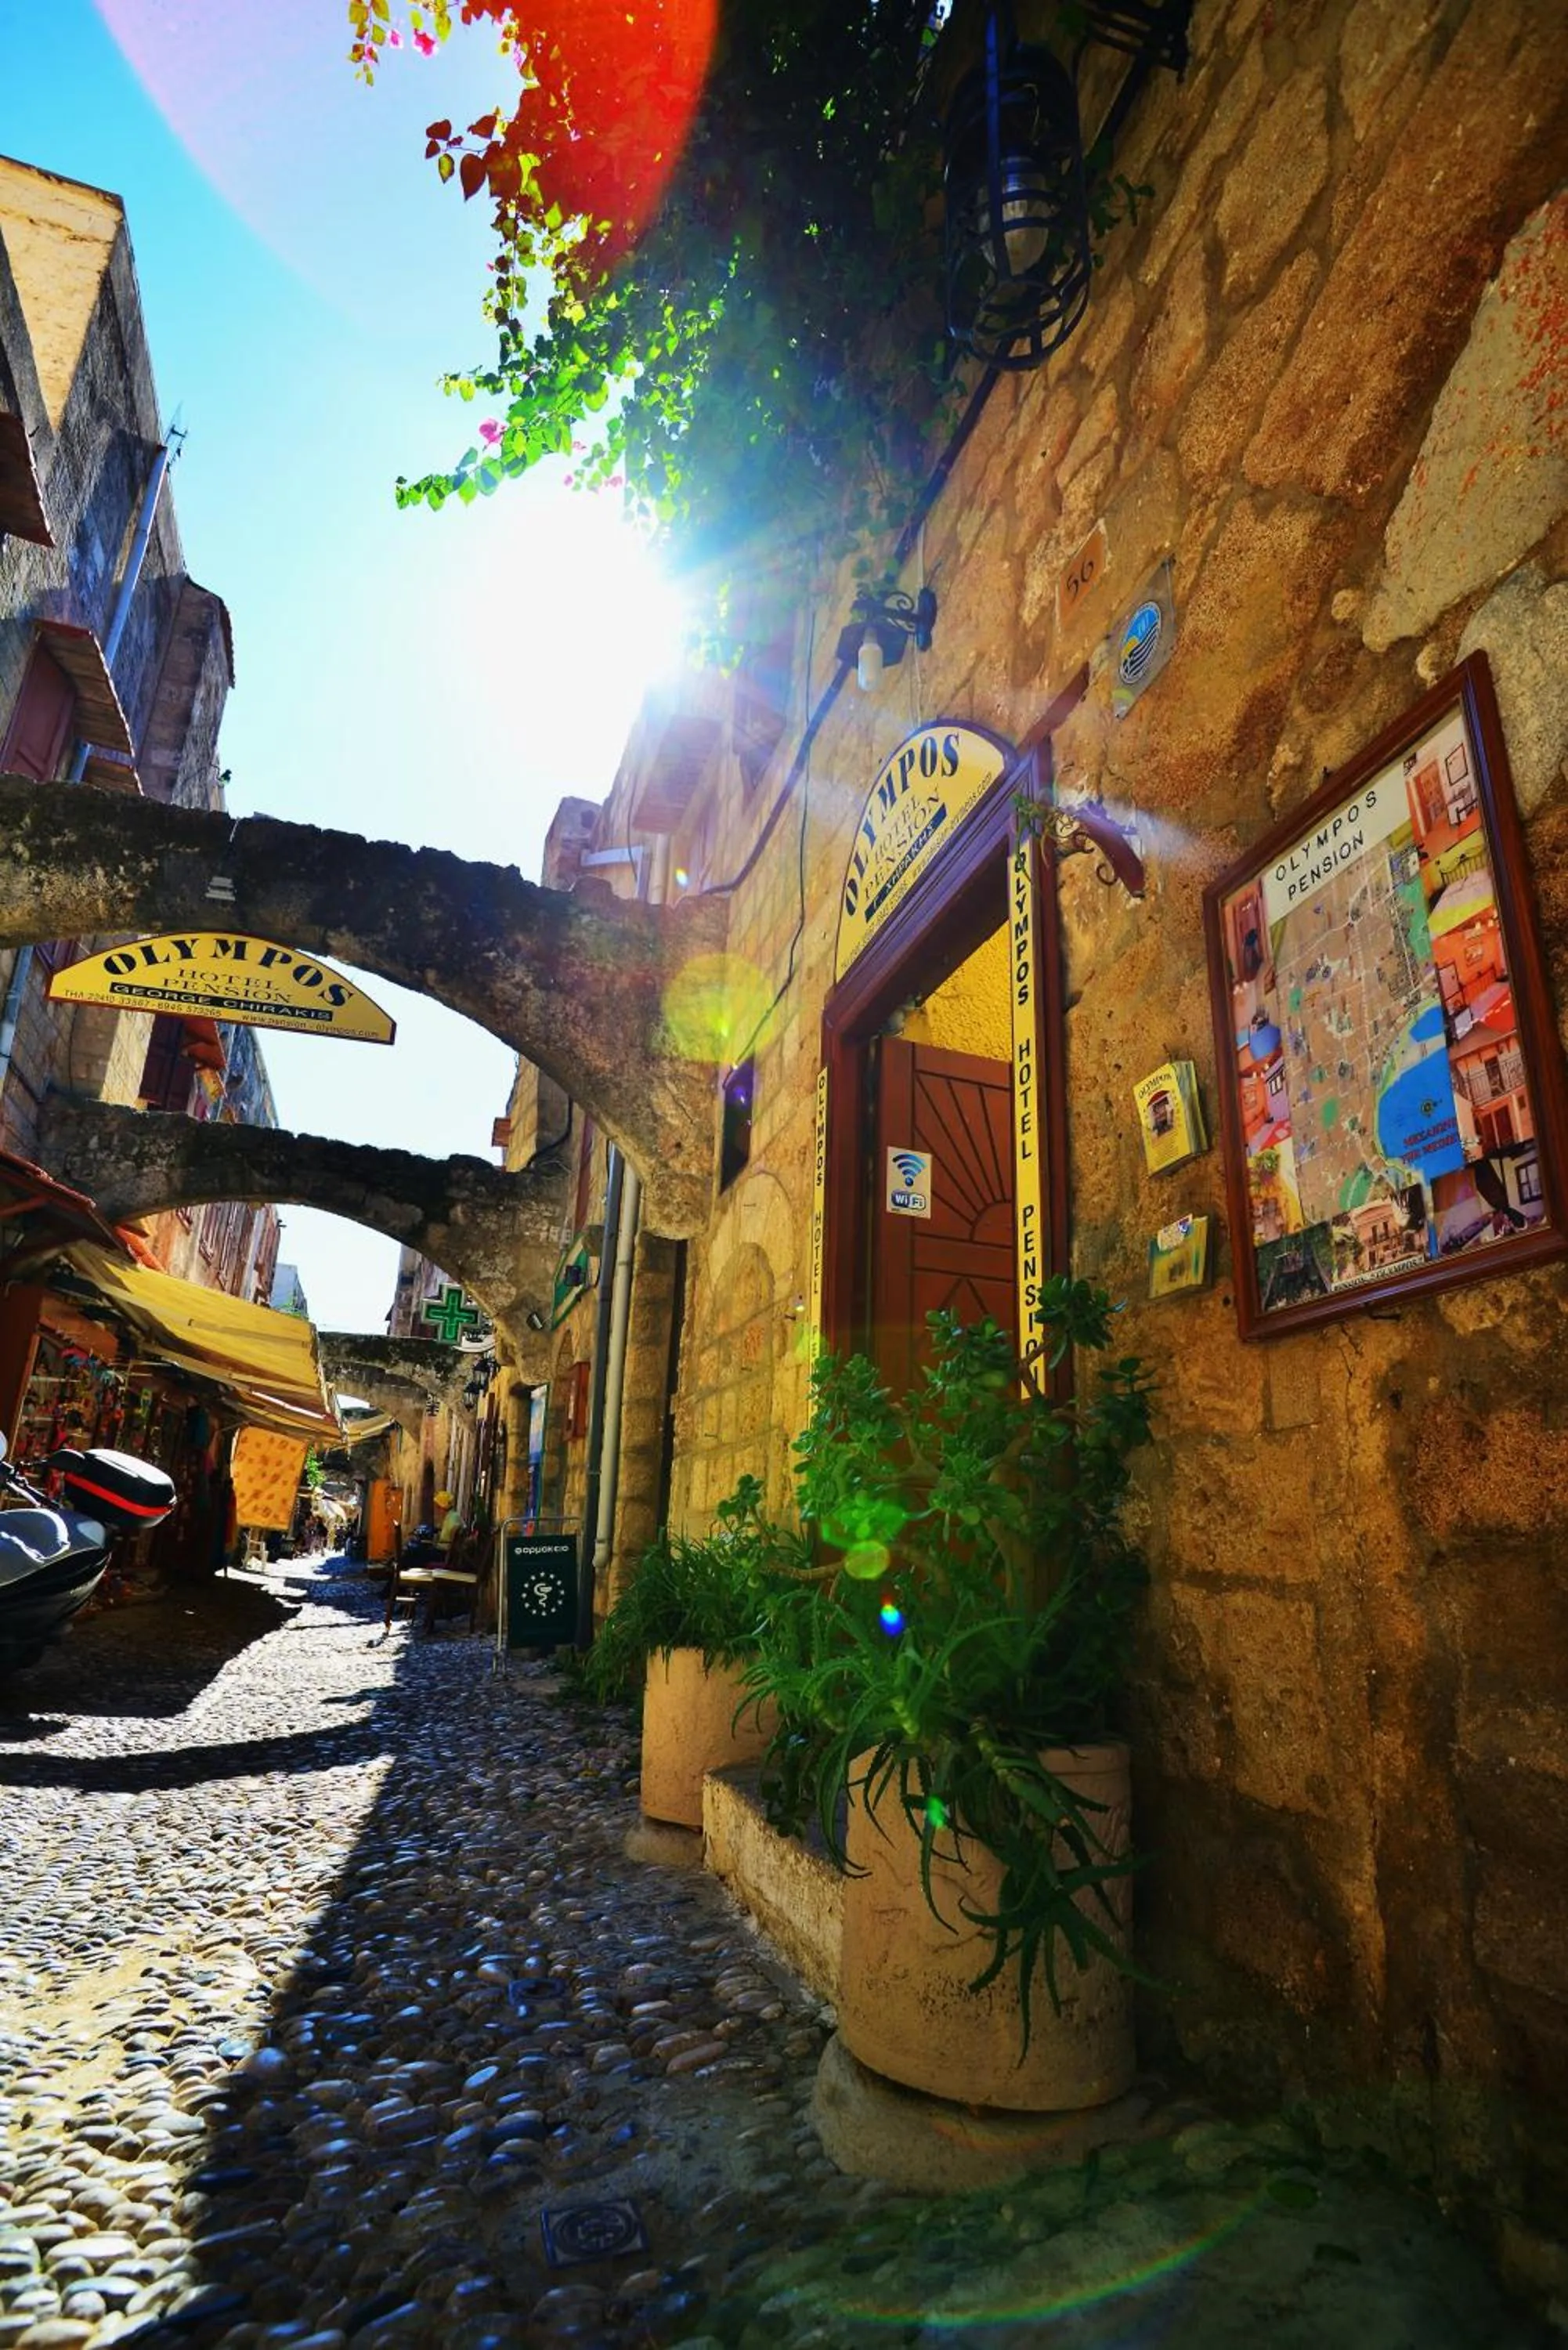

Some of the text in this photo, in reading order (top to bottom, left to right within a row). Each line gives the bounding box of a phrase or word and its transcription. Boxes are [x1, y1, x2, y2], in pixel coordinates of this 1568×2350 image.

[844, 732, 960, 917] OLYMPOS
[864, 783, 938, 902] PENSION
[875, 794, 921, 862] HOTEL
[1276, 790, 1377, 882] OLYMPOS
[1288, 830, 1364, 901] PENSION
[1015, 851, 1030, 1005] OLYMPOS
[103, 938, 353, 1007] OLYMPOS
[114, 985, 331, 1020] GEORGE CHIRAKIS
[162, 978, 292, 1003] PENSION
[178, 968, 278, 991] HOTEL
[816, 1075, 826, 1187] OLYMPOS
[1019, 1039, 1031, 1159] HOTEL
